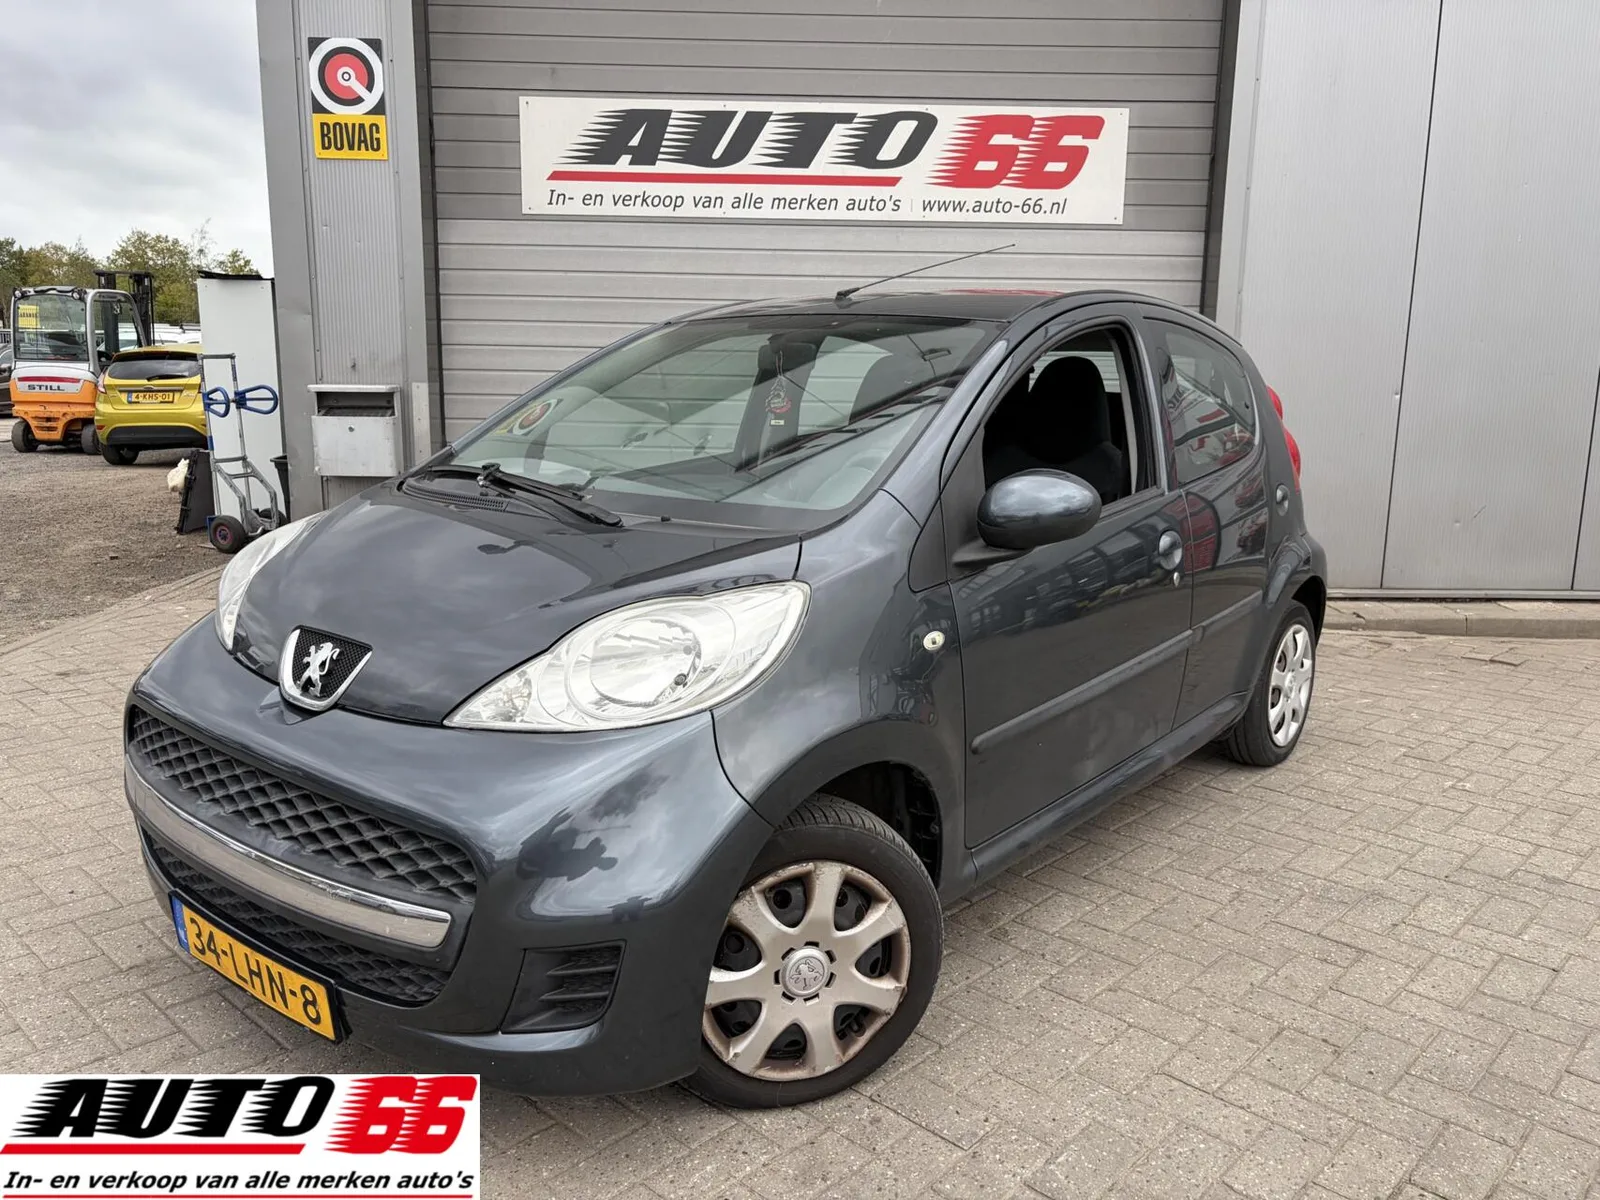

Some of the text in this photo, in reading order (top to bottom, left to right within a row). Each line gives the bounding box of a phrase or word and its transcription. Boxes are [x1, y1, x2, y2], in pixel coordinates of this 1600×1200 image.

[319, 121, 381, 152] BOVAG
[553, 108, 1106, 190] AUTO 66
[547, 189, 1068, 215] In- en verkoop van alle merken auto's www.auto-66.nl
[189, 917, 322, 1025] 34-LHN-8
